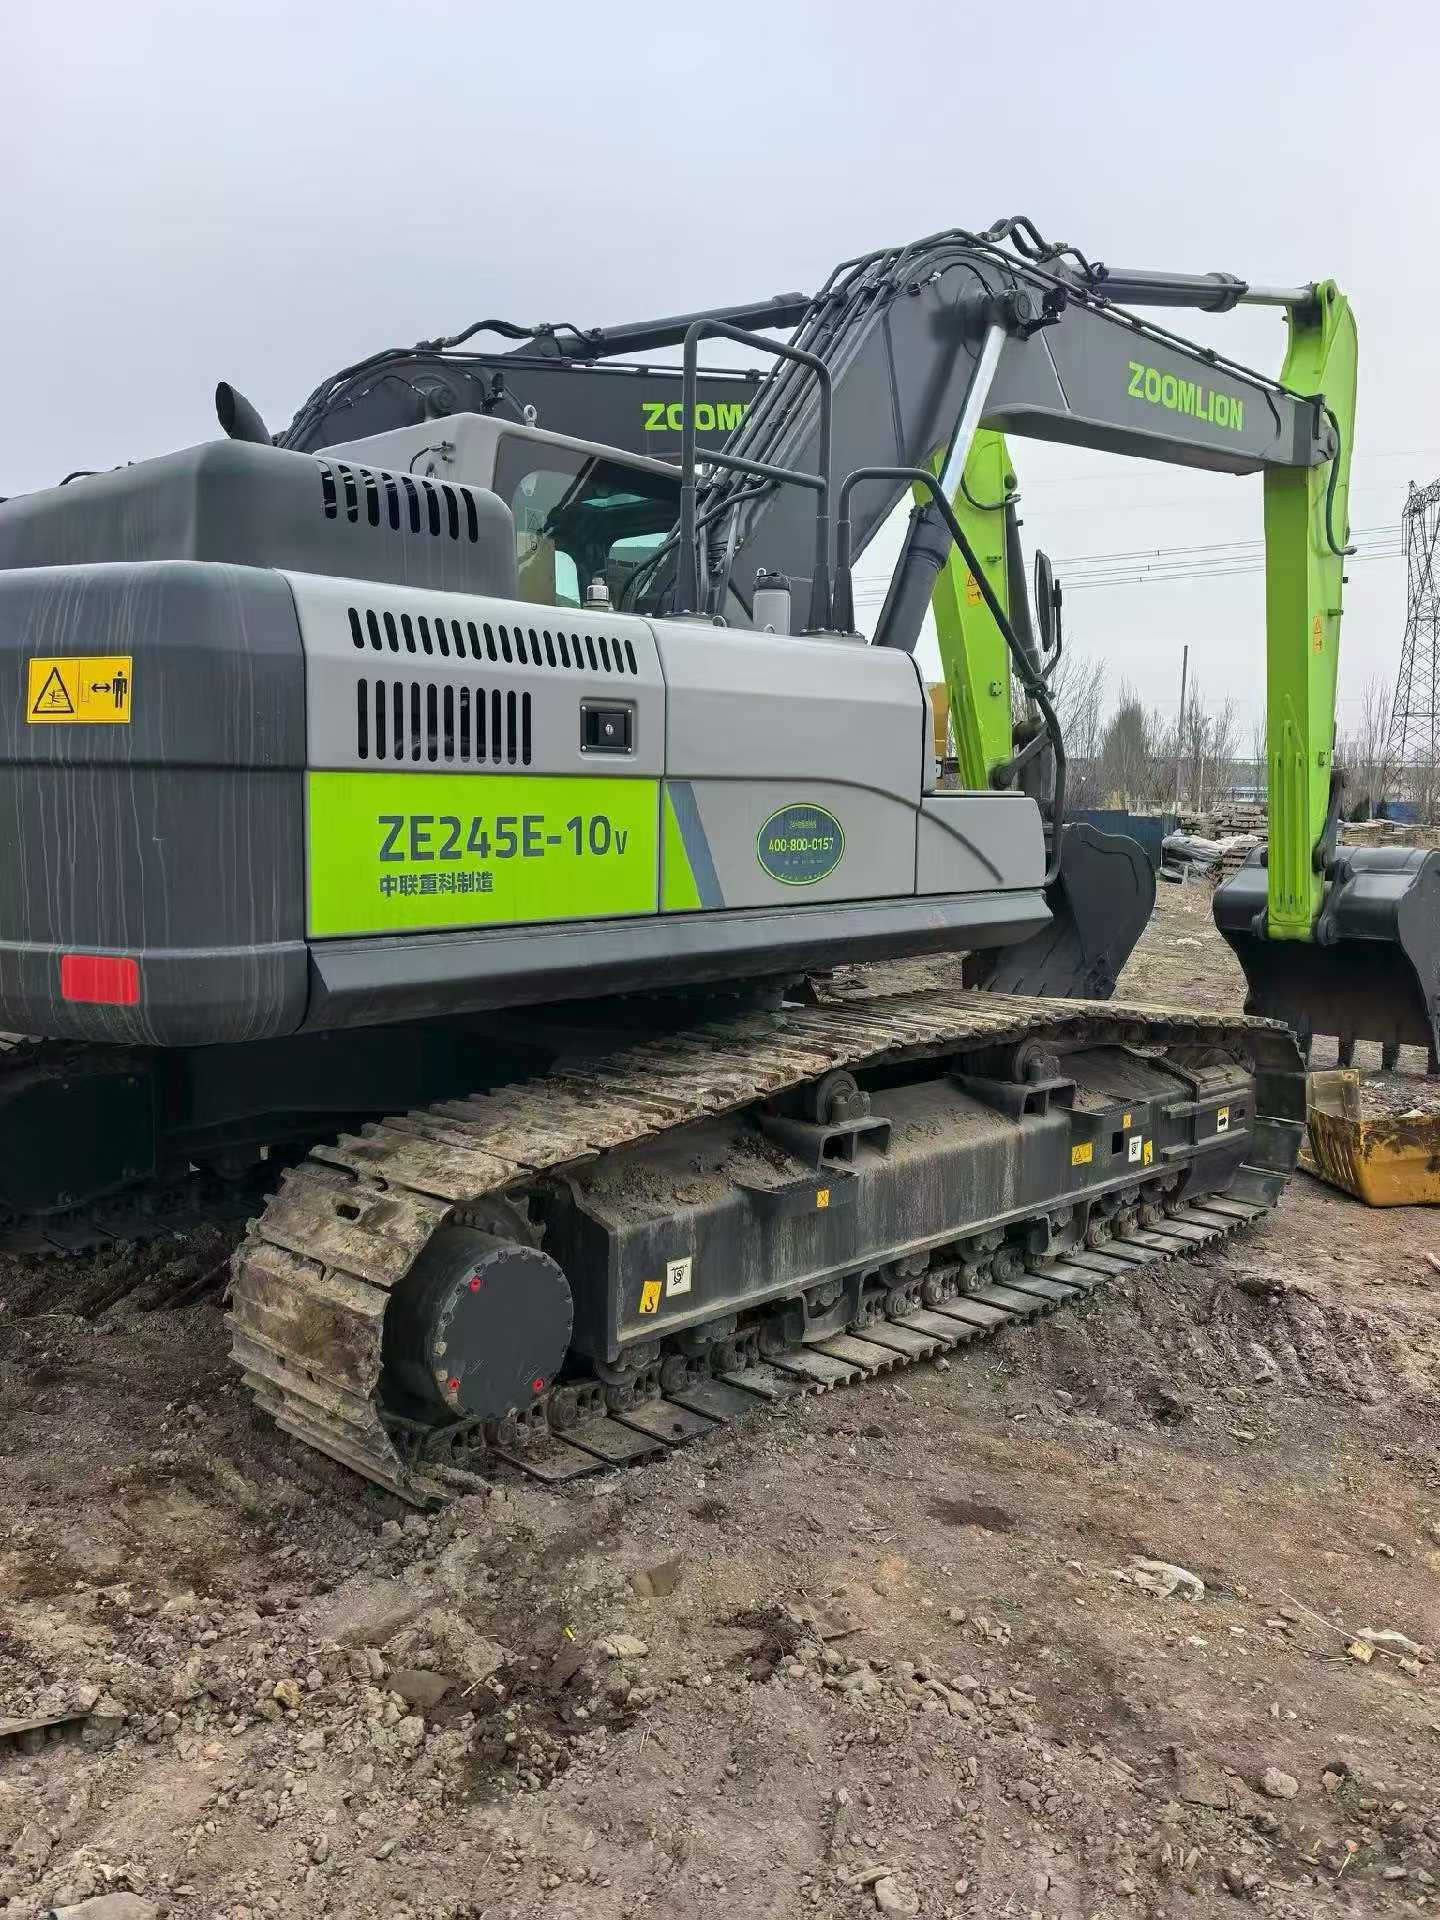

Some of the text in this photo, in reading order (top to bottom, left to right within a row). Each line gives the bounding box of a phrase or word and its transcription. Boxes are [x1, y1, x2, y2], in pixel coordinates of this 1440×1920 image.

[1128, 361, 1242, 431] ZOOMLION
[642, 403, 752, 430] ZOOM
[379, 871, 493, 897] 中联重科制造
